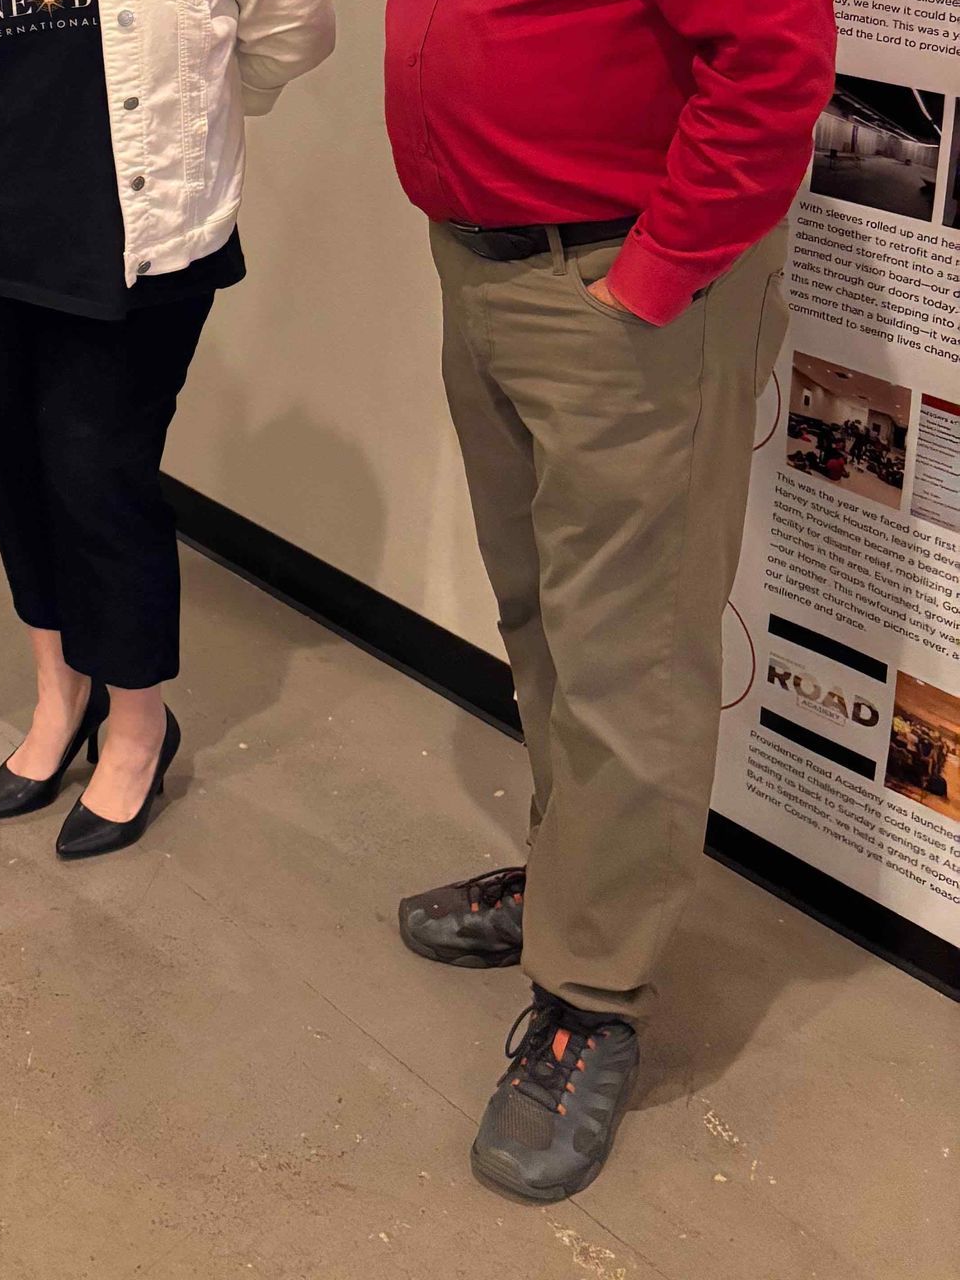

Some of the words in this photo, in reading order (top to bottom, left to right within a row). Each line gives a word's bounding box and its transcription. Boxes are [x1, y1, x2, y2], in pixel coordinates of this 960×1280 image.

[854, 0, 869, 8] we
[872, 0, 901, 13] knew
[903, 6, 911, 16] it
[914, 10, 946, 21] could
[856, 29, 873, 40] the
[876, 32, 902, 45] Lord
[904, 38, 916, 48] to
[919, 42, 960, 56] provide
[800, 202, 823, 214] With
[826, 209, 863, 225] sleeves
[866, 220, 897, 234] rolled
[899, 229, 914, 239] up
[916, 233, 939, 245] and
[941, 237, 960, 251] hea
[794, 262, 821, 273] walks
[824, 268, 864, 286] through
[867, 282, 885, 292] our
[888, 286, 919, 303] doors
[856, 248, 909, 269] storefront
[912, 261, 934, 275] into
[937, 270, 944, 278] a
[789, 303, 843, 325] committed
[846, 319, 857, 329] to
[860, 325, 895, 343] seeing
[897, 334, 921, 350] lives
[924, 345, 960, 363] chang
[775, 485, 808, 507] Harvey
[811, 502, 840, 520] struck
[843, 515, 889, 541] Houston,
[864, 537, 905, 562] became
[908, 558, 915, 566] a
[918, 560, 959, 584] beacon
[764, 582, 812, 607] resilience
[814, 603, 833, 616] and
[835, 612, 866, 631] grace.
